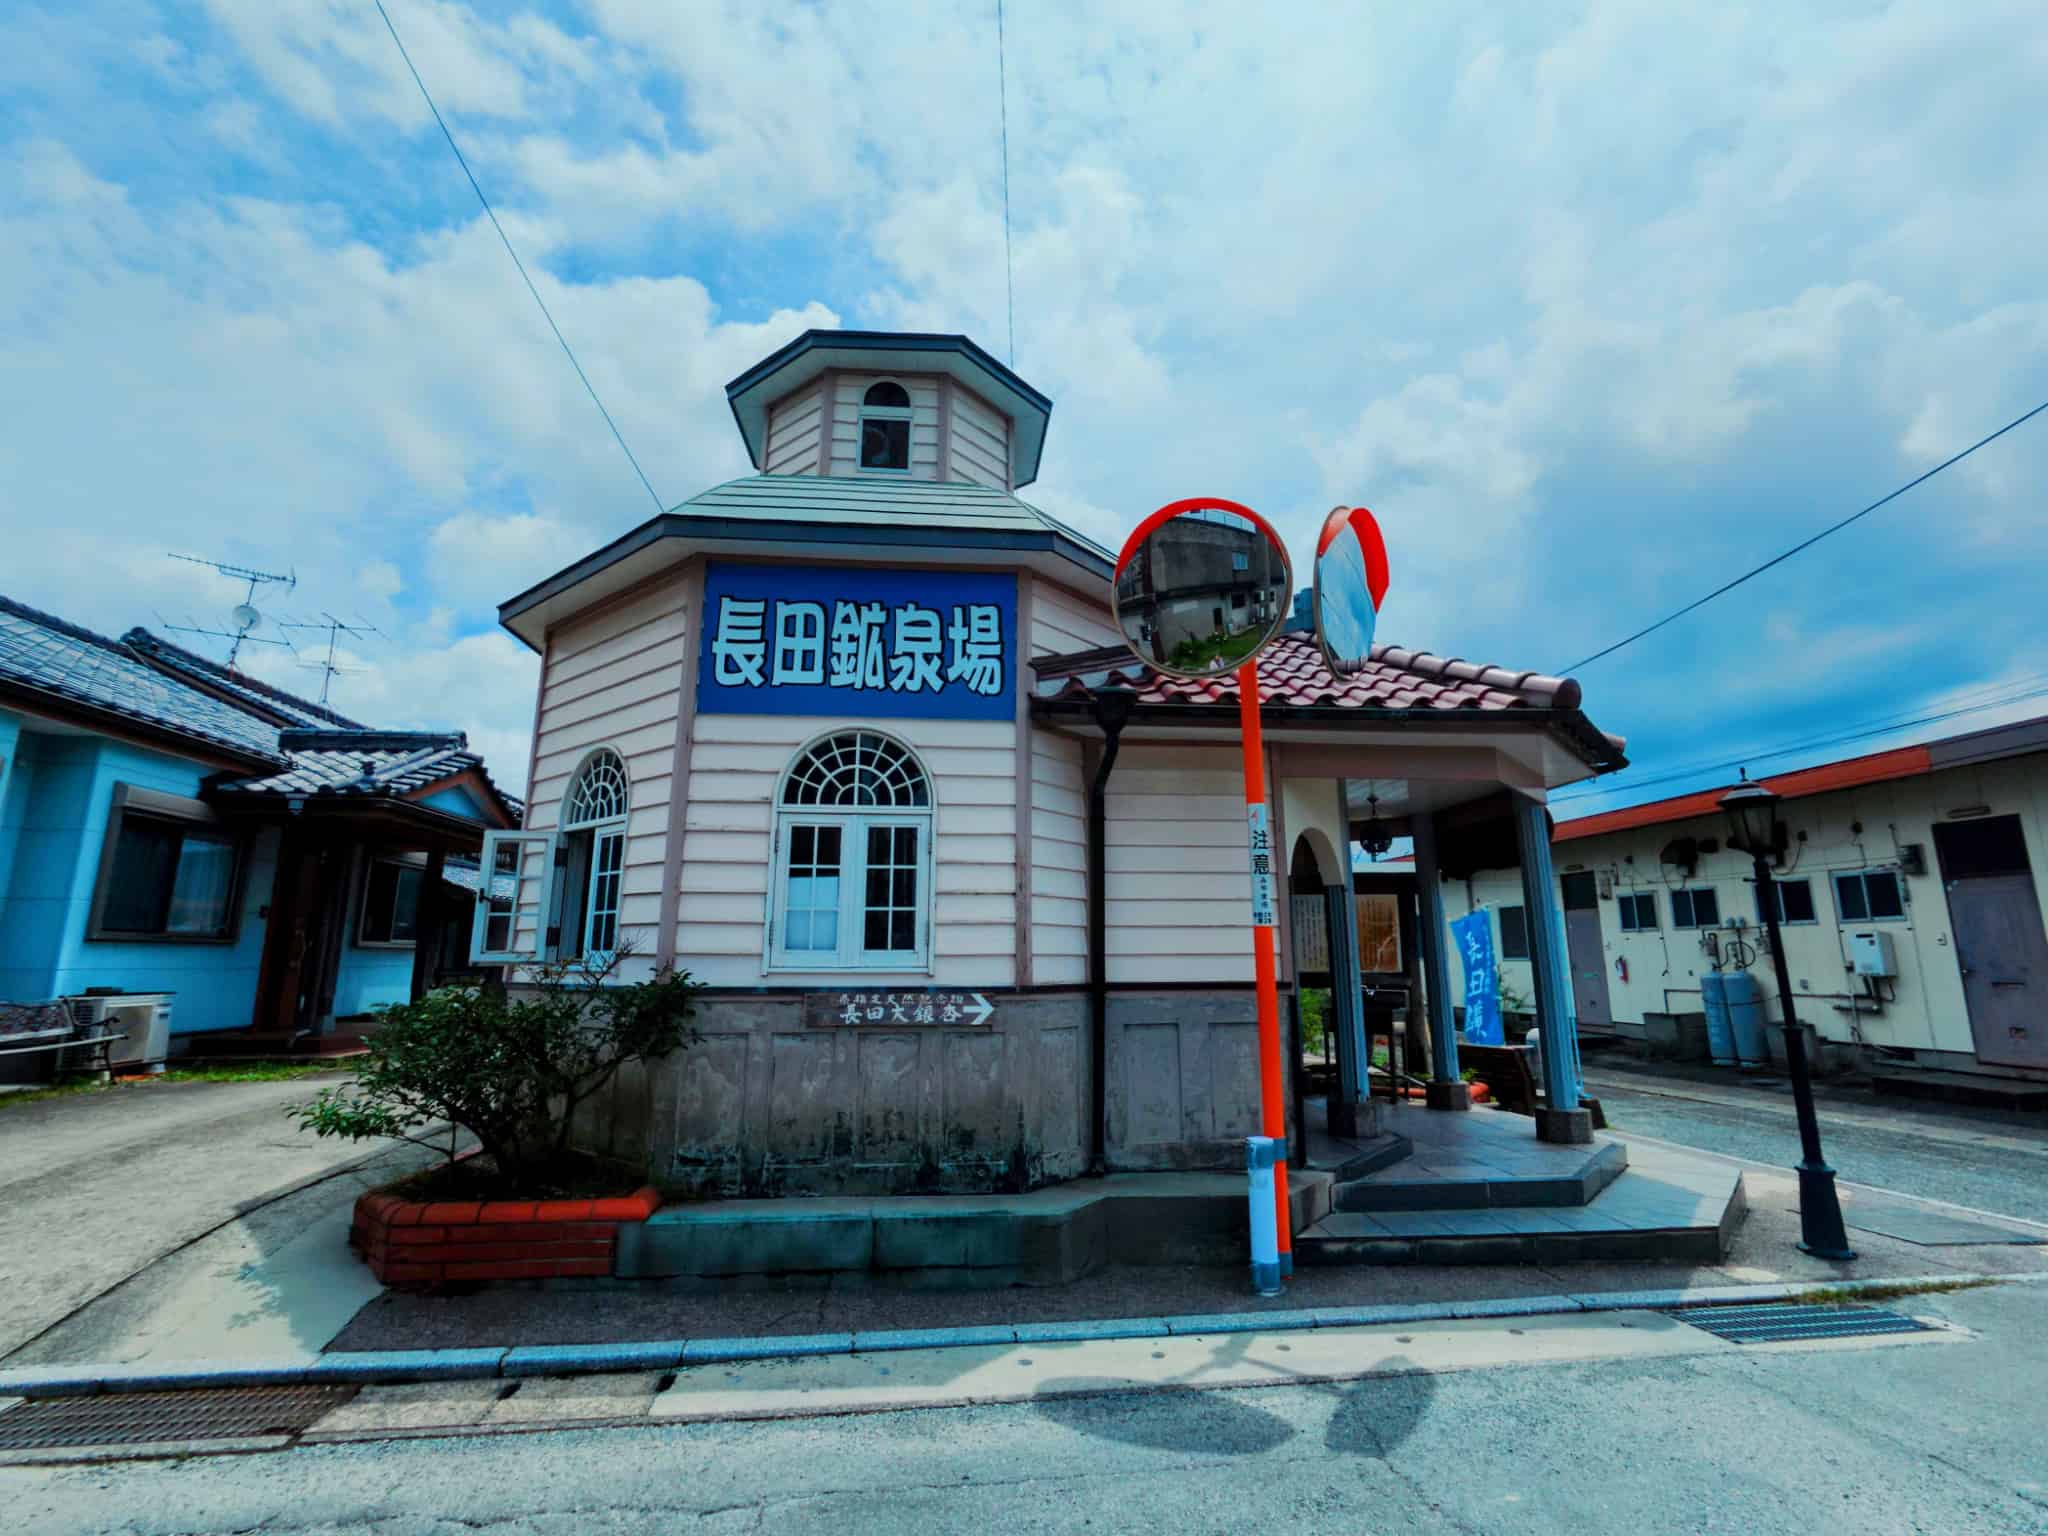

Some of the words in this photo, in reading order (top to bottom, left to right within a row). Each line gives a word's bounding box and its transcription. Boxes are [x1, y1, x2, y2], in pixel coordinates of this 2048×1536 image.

[711, 596, 1002, 695] 長田鉱泉場
[1252, 829, 1269, 875] 注意
[839, 1003, 963, 1025] 長田大銀杏
